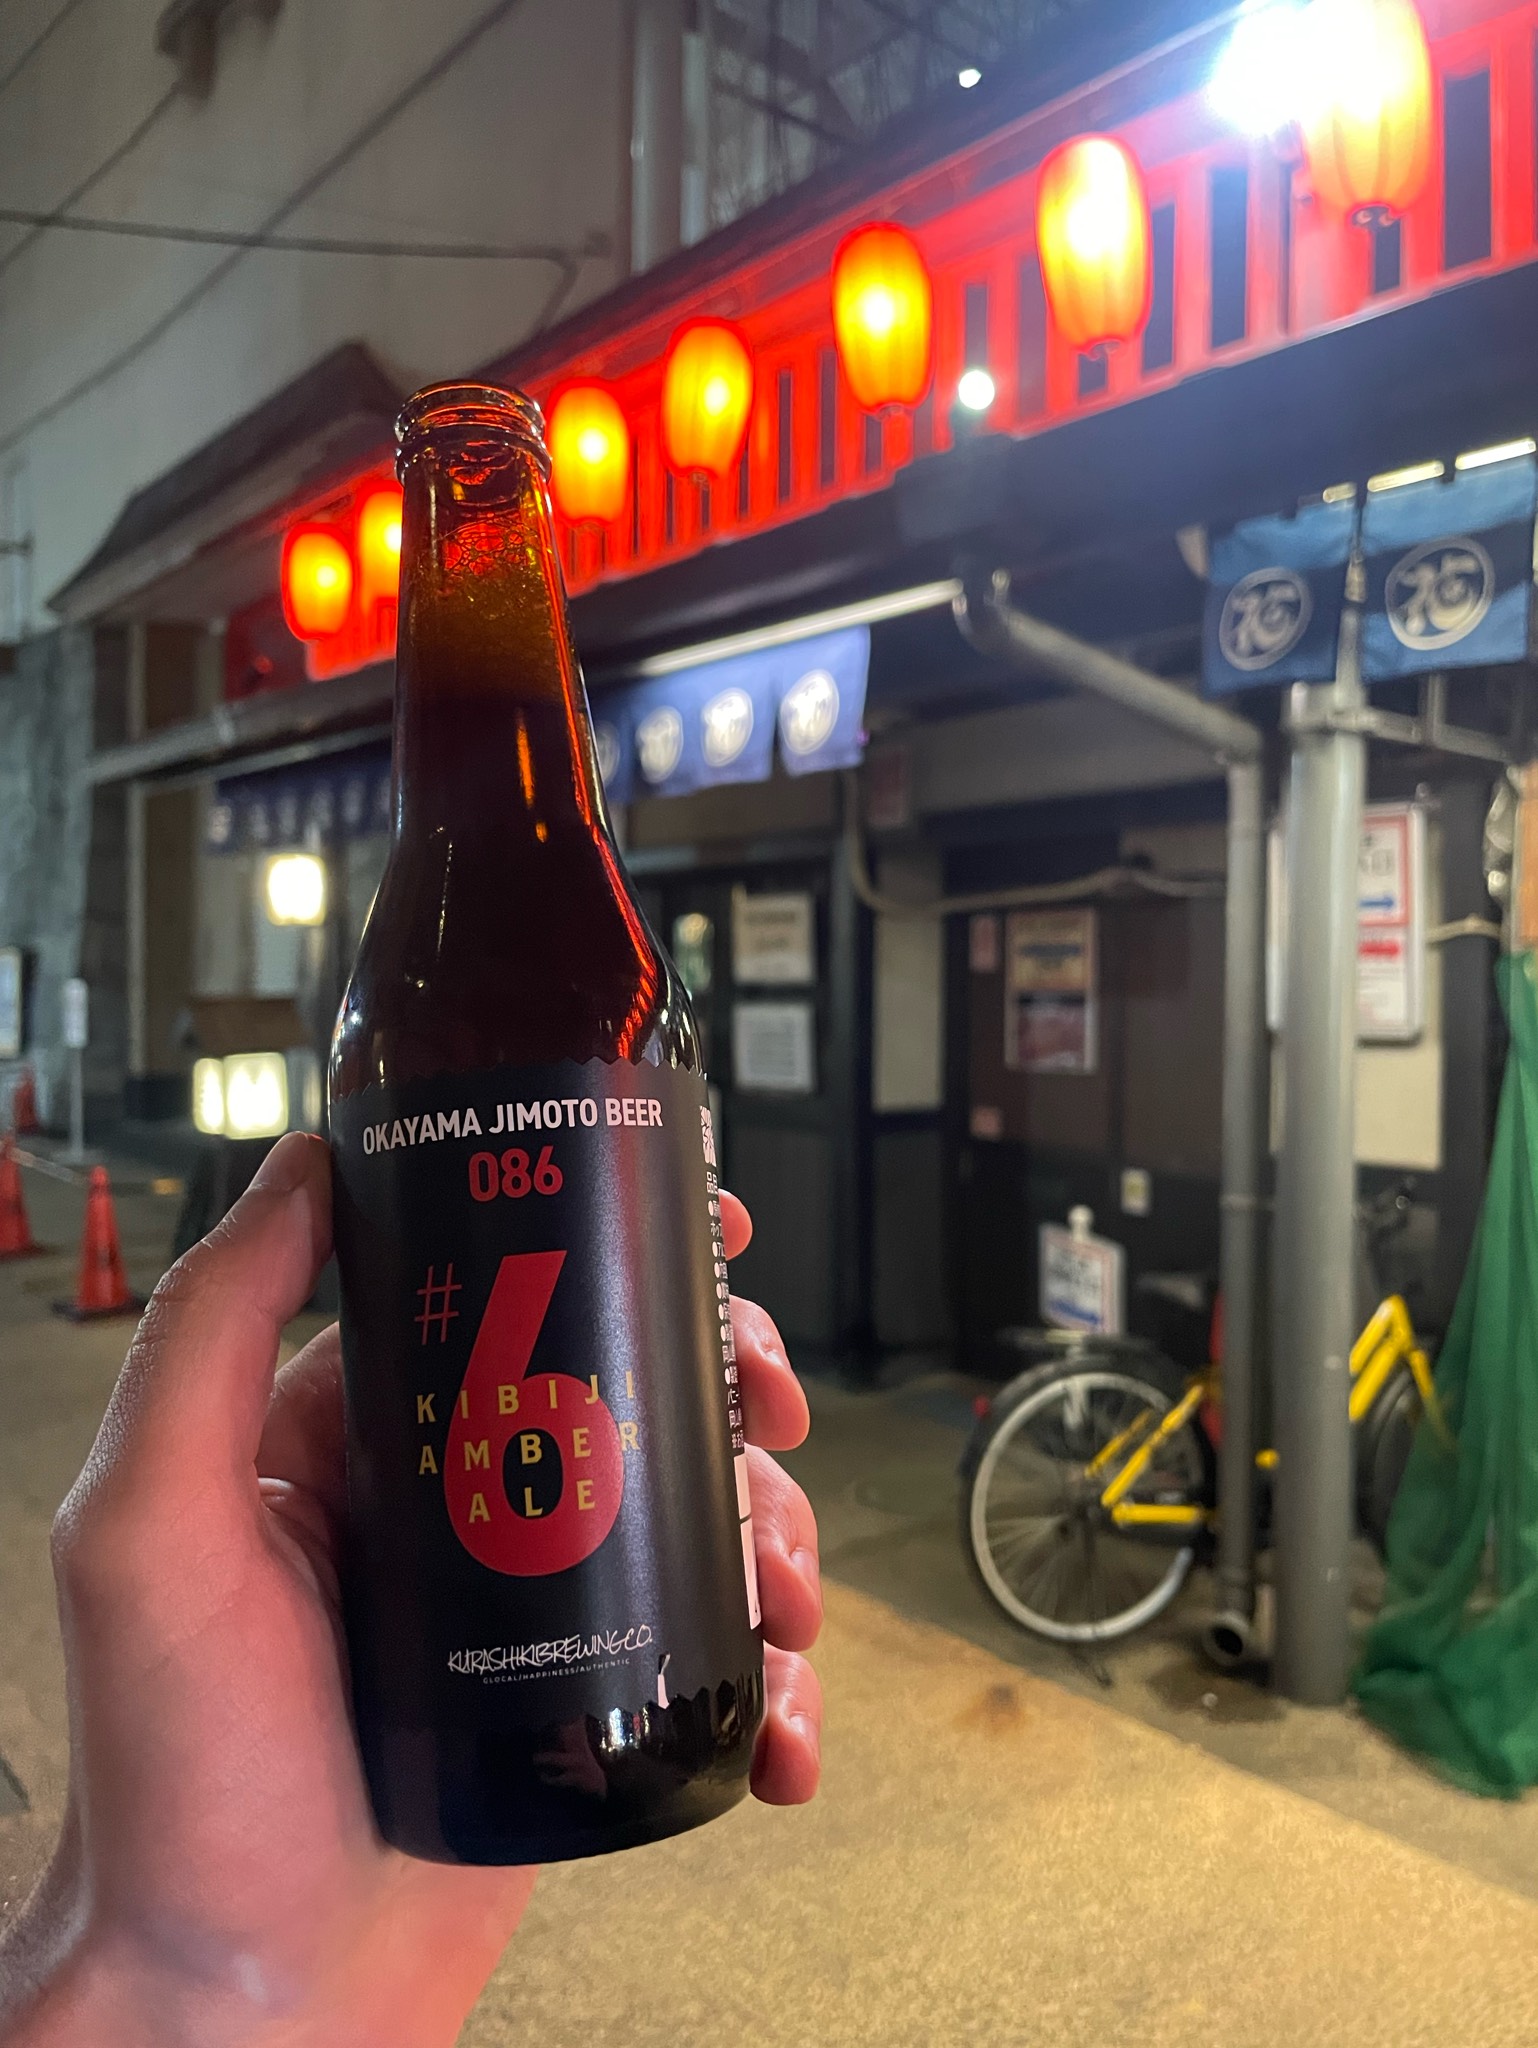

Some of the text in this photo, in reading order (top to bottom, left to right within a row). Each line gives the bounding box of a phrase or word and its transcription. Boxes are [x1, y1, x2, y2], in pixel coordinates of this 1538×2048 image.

[363, 1098, 664, 1155] OKAYAMA JIMOTO BEER
[468, 1145, 563, 1202] 086
[417, 1370, 636, 1424] KIBIJI
[418, 1421, 641, 1476] AMBER
[468, 1479, 597, 1524] ALE
